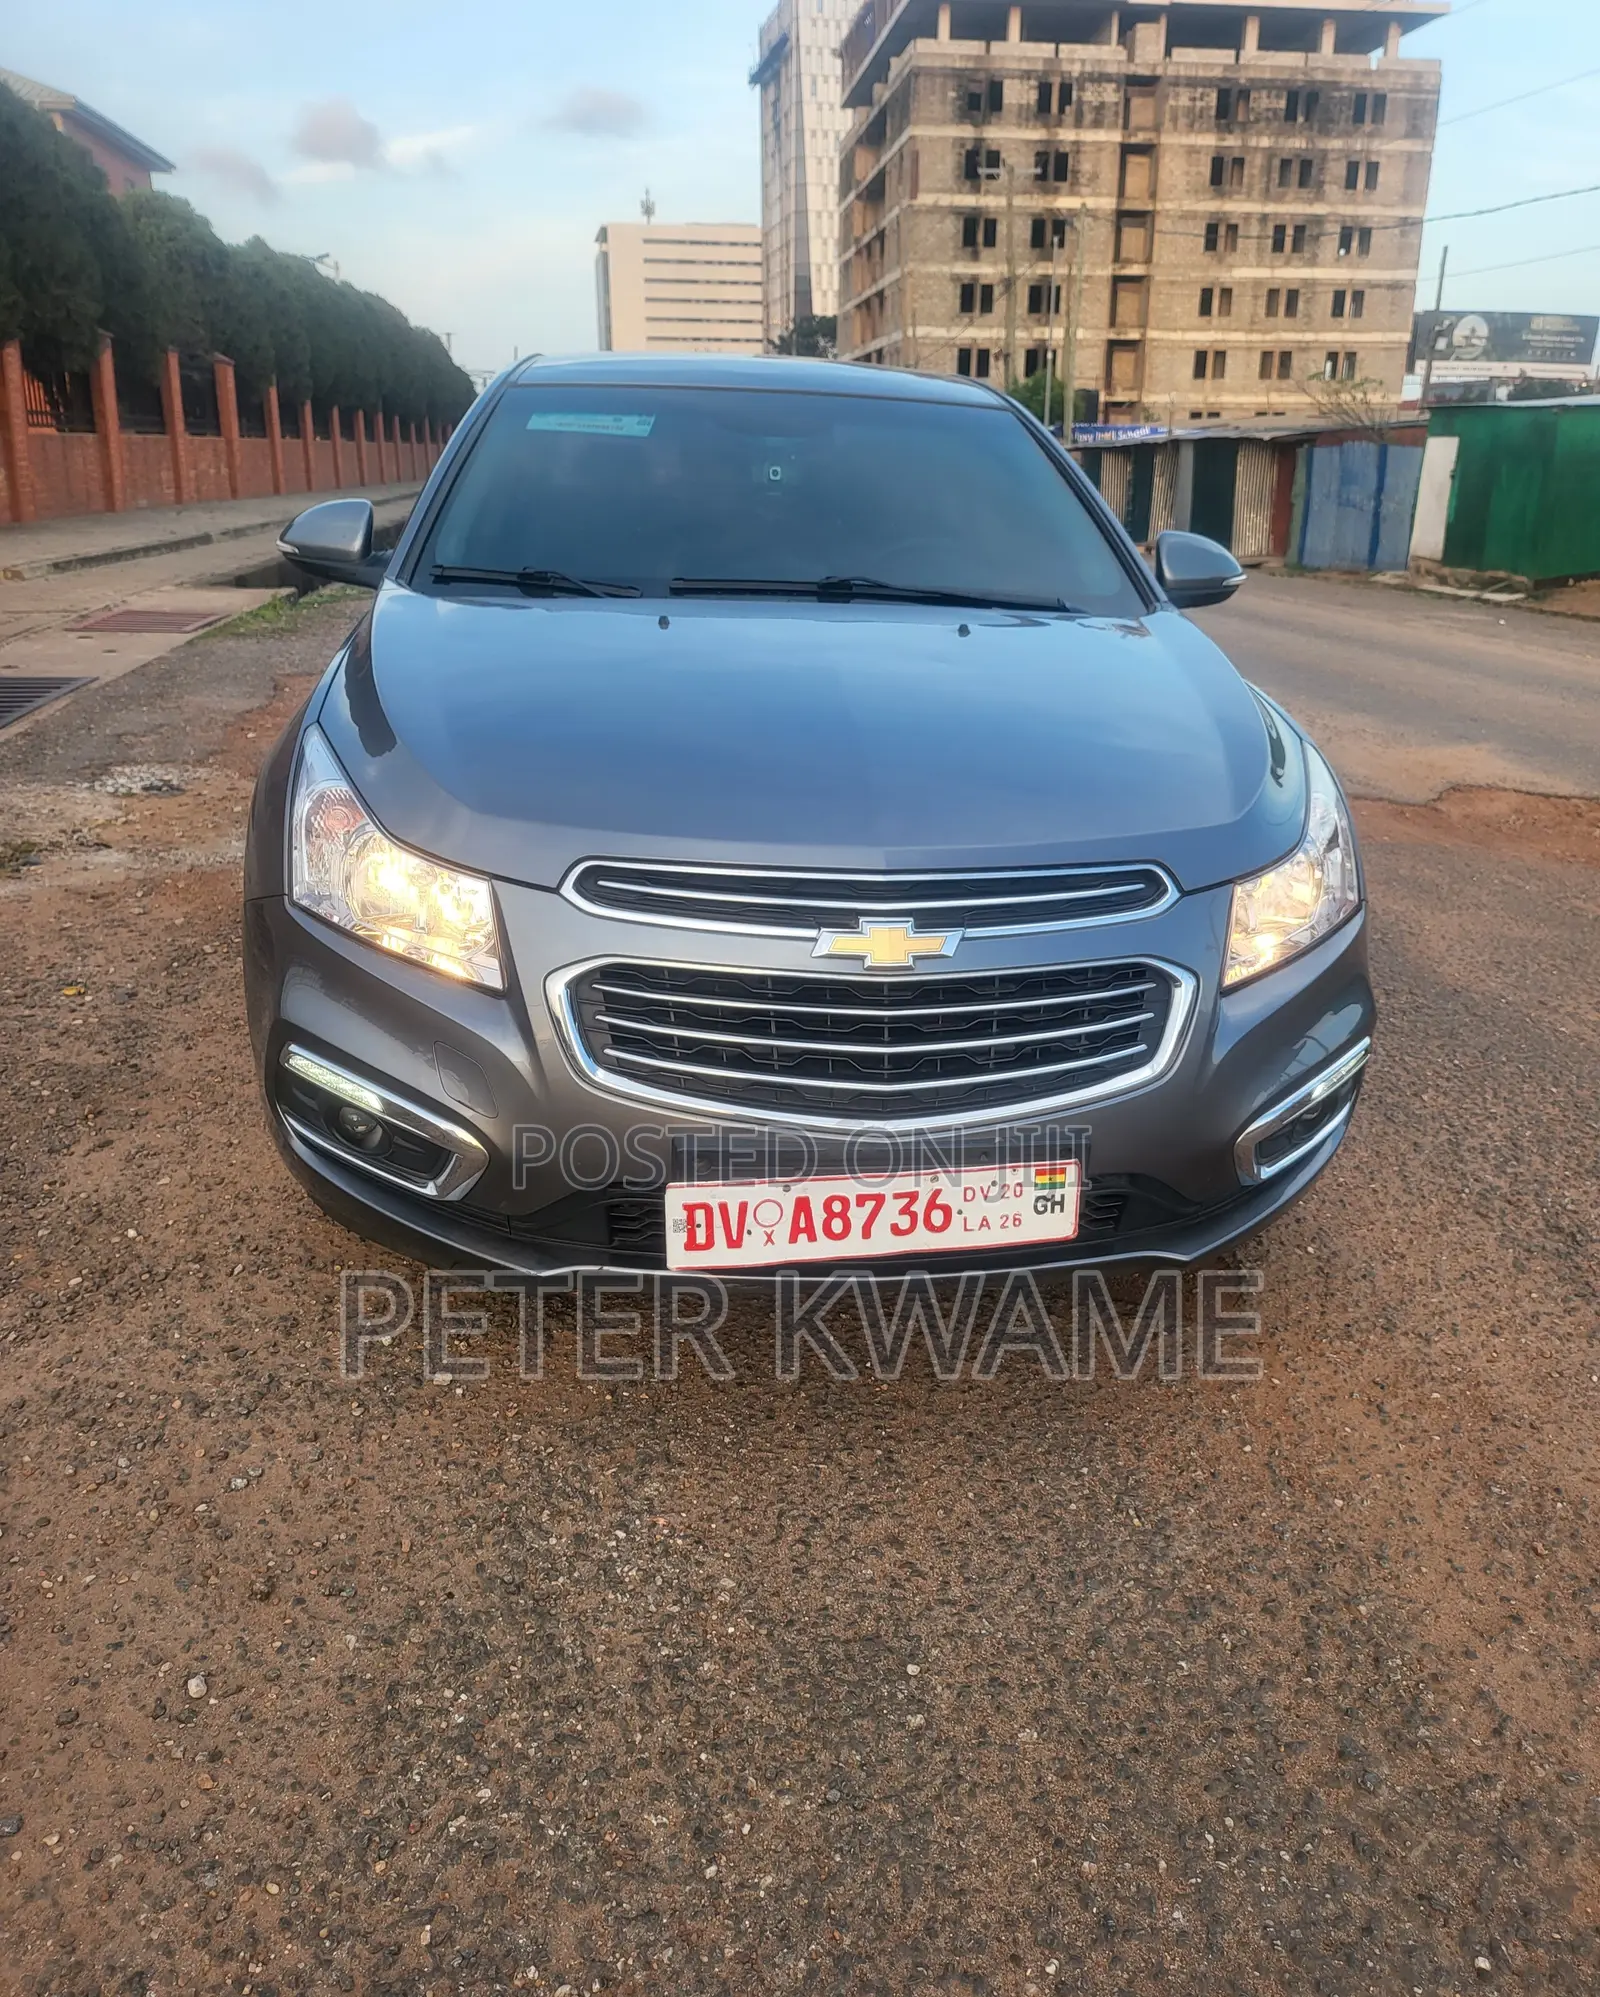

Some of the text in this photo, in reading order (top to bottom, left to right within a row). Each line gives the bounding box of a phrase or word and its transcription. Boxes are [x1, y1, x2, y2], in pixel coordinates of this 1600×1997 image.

[963, 1181, 1024, 1203] DV 20
[1033, 1193, 1066, 1216] GH
[682, 1200, 748, 1252] DV
[788, 1188, 953, 1245] A8736
[963, 1211, 1023, 1233] LA 26
